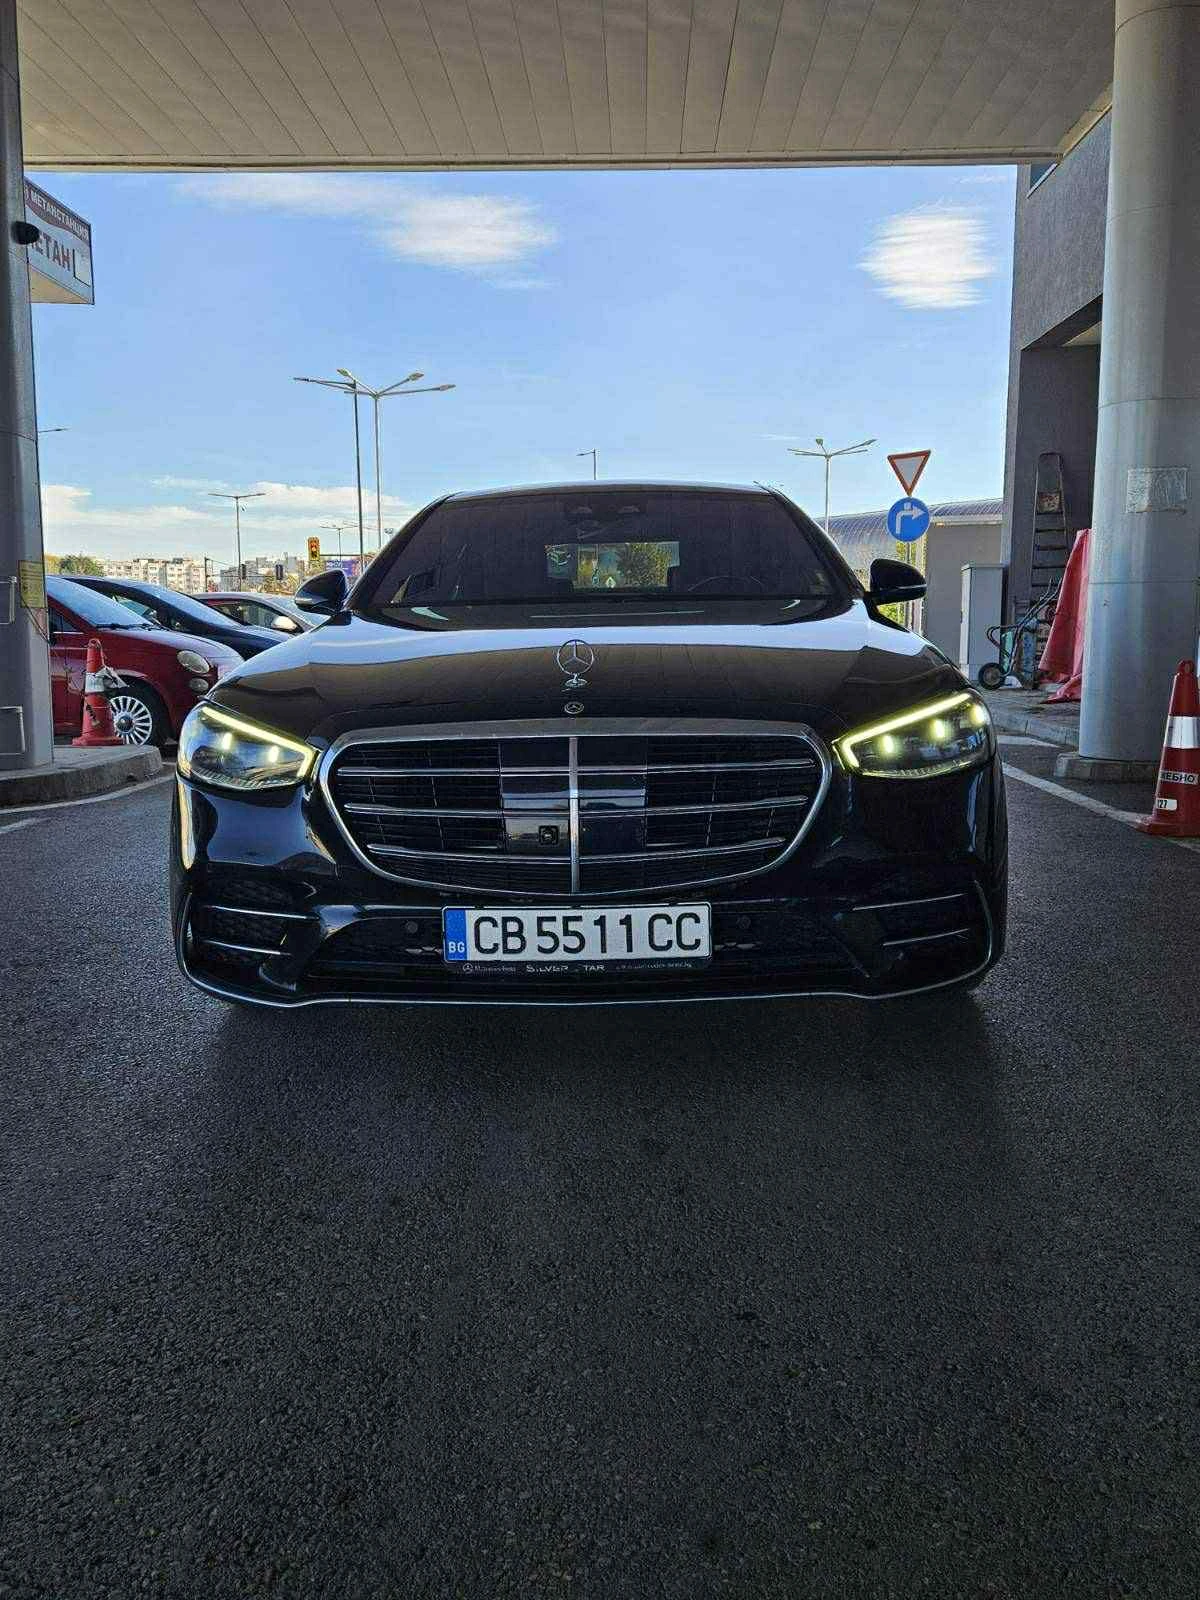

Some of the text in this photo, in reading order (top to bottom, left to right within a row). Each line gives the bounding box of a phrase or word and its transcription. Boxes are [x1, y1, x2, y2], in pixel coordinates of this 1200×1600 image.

[537, 914, 634, 954] 5511
[448, 941, 466, 953] BG
[577, 964, 606, 973] TAR
